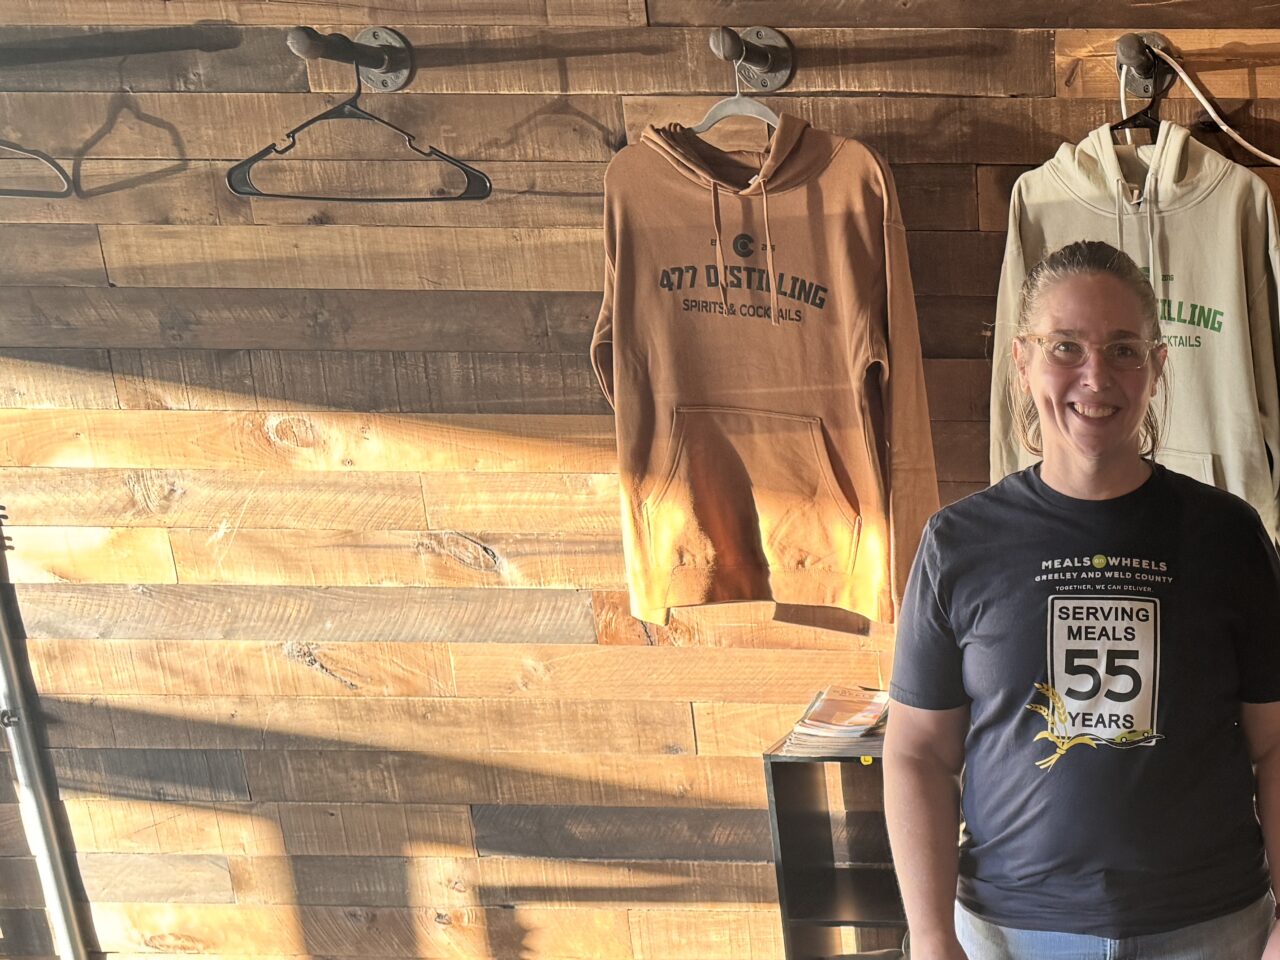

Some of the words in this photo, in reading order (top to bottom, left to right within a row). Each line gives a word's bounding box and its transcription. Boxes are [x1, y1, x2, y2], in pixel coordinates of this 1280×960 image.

[659, 265, 698, 291] 477
[728, 303, 736, 315] &
[739, 304, 802, 323] COCKAILS
[1041, 556, 1091, 570] MEALS
[1107, 556, 1168, 572] WHEELS
[1034, 572, 1078, 582] GREELEY
[1104, 571, 1132, 579] WELD
[1134, 573, 1173, 584] COUNTY
[1057, 605, 1150, 623] SERVING
[1067, 625, 1136, 642] MEALS
[1064, 648, 1142, 703] 55
[1068, 712, 1134, 730] YEARS
